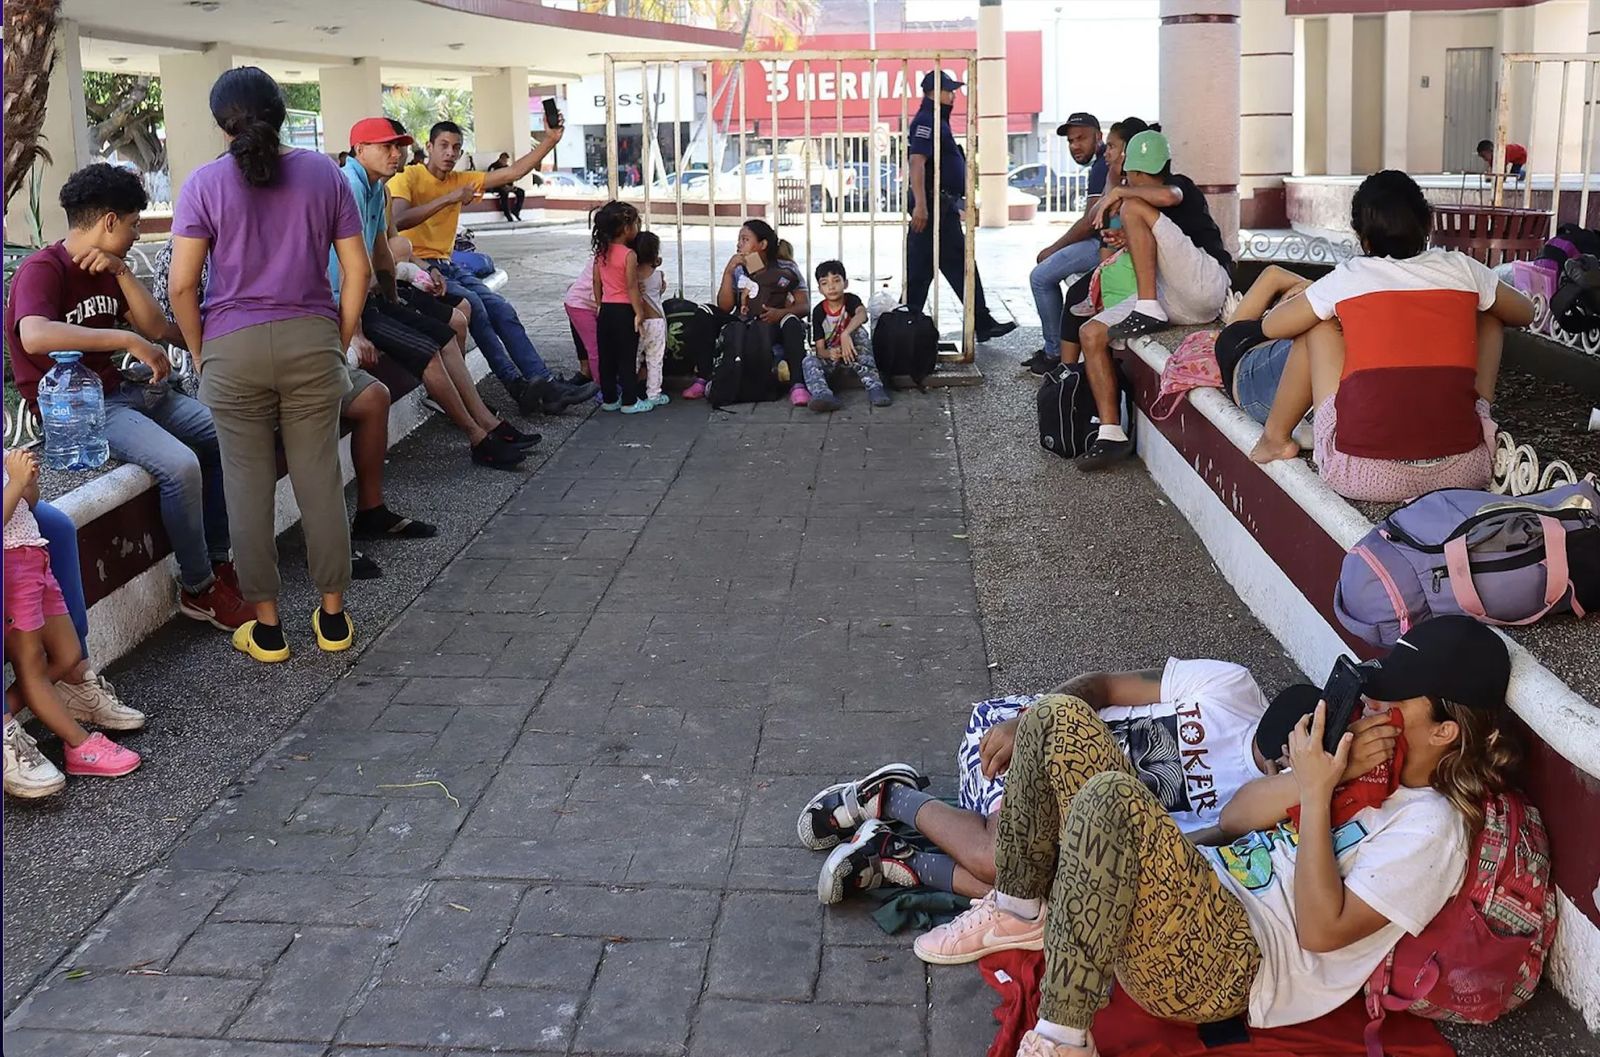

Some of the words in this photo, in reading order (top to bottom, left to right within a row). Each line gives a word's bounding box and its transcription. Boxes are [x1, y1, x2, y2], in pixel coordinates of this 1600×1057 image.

[594, 92, 665, 107] BSSU
[52, 405, 70, 416] ciel
[1175, 699, 1218, 818] JOKER
